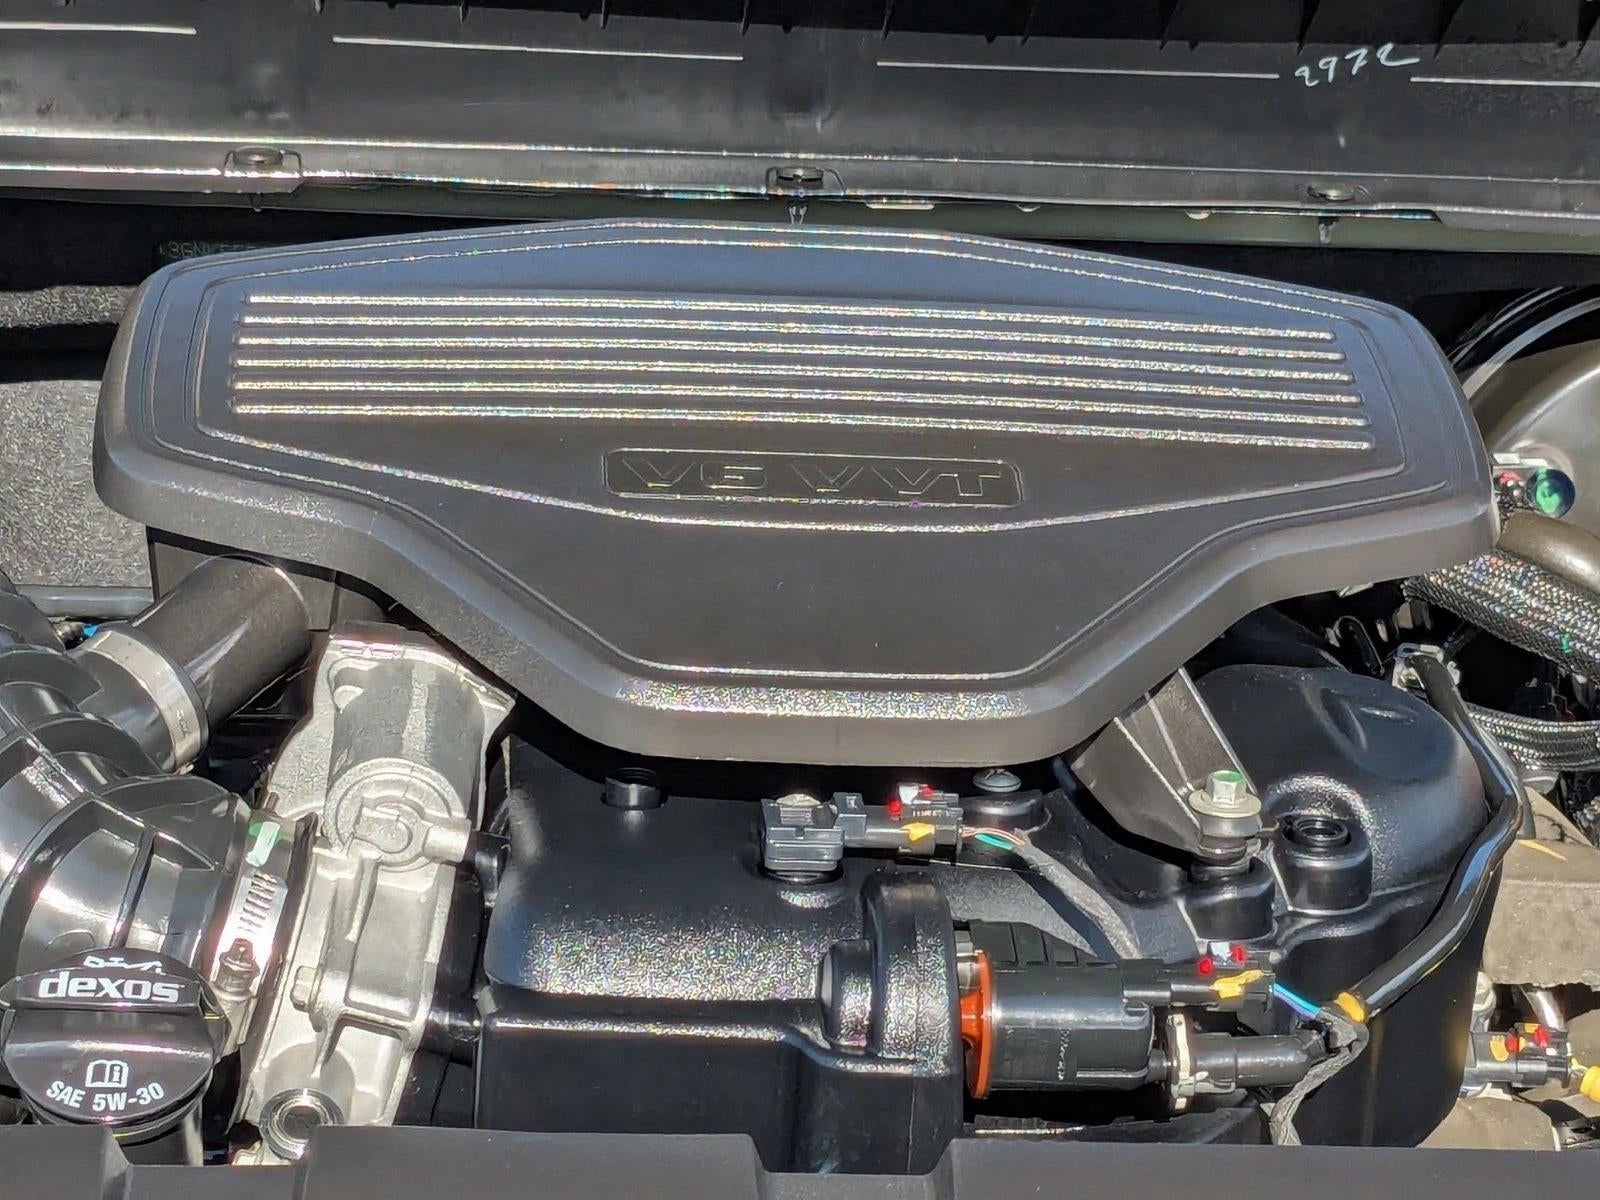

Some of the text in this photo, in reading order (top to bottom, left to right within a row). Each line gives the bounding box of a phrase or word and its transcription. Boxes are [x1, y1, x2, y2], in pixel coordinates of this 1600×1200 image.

[621, 459, 1001, 497] V6 VVT
[38, 971, 180, 1003] dexos
[46, 1080, 165, 1112] SAE 5W-30
